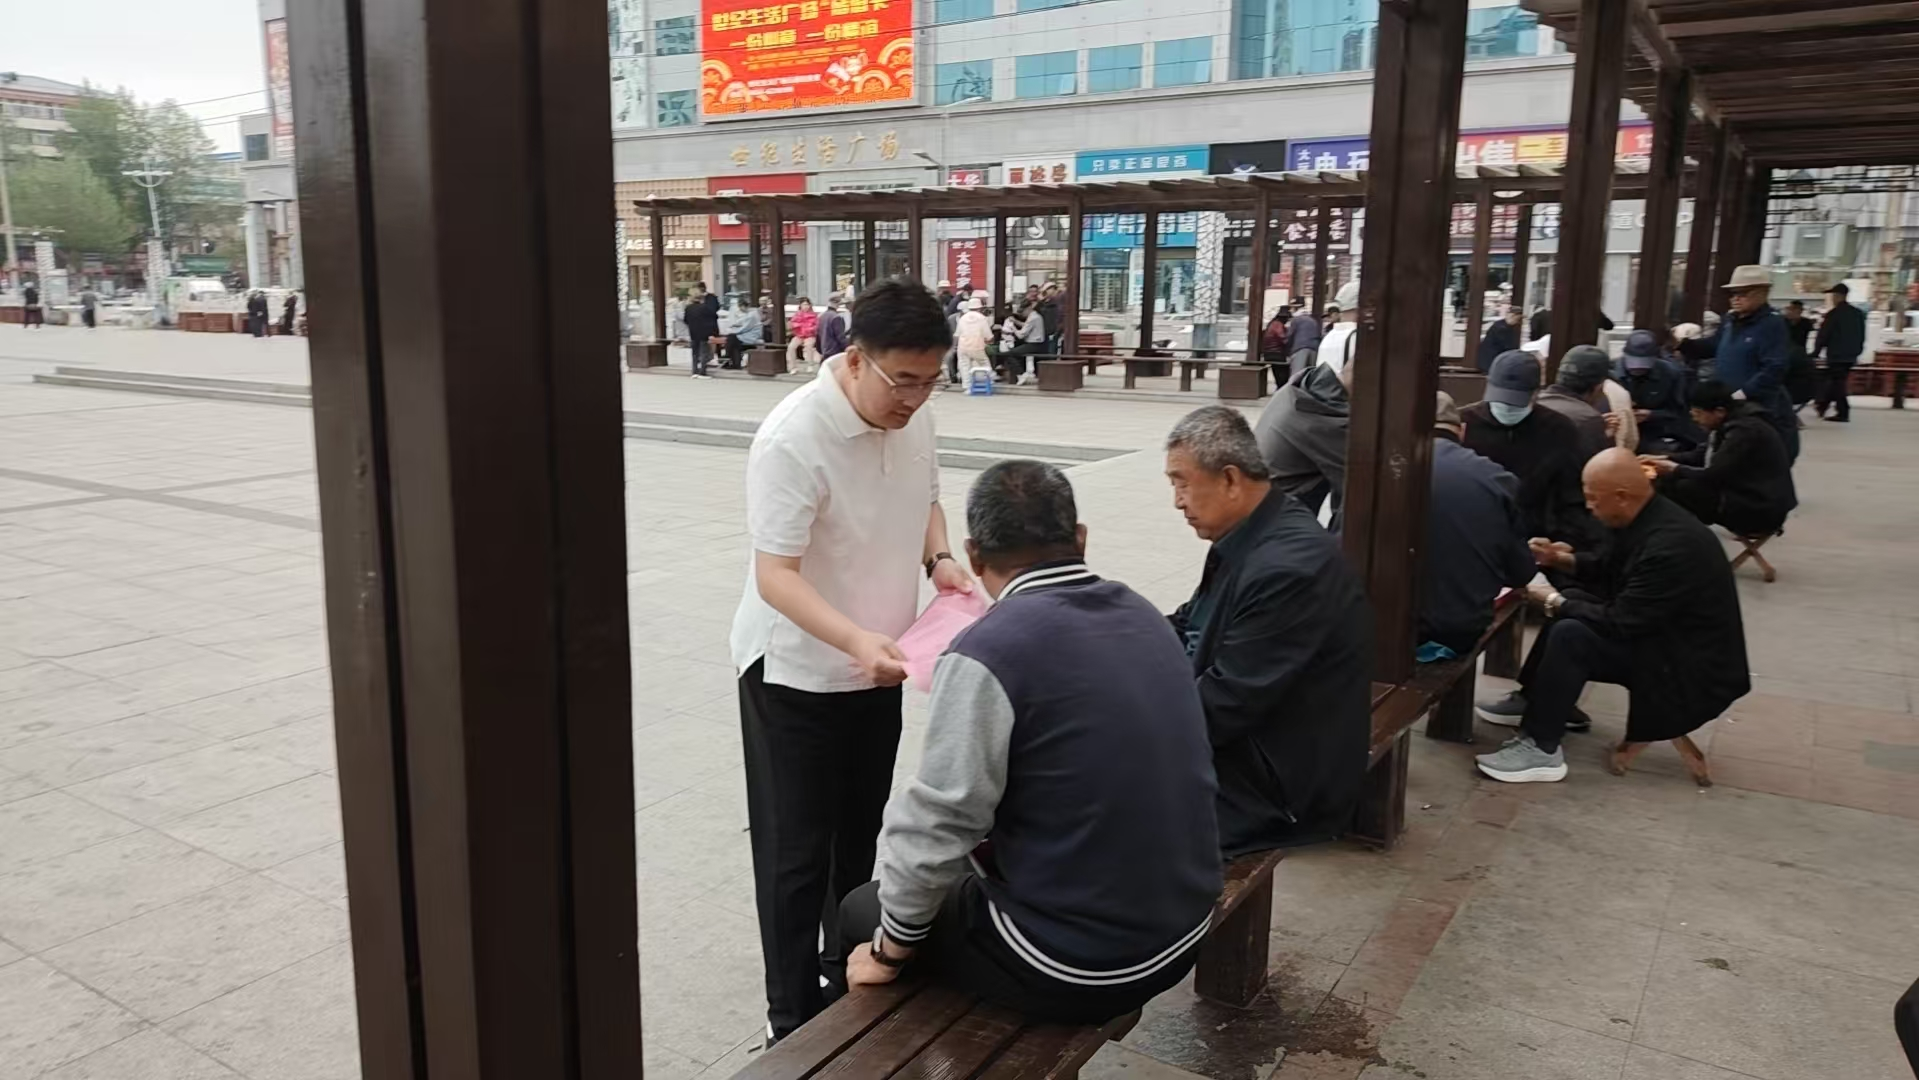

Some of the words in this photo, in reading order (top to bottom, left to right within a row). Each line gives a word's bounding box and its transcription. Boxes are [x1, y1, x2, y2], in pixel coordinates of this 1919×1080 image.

[730, 131, 899, 167] 世纪生活广场
